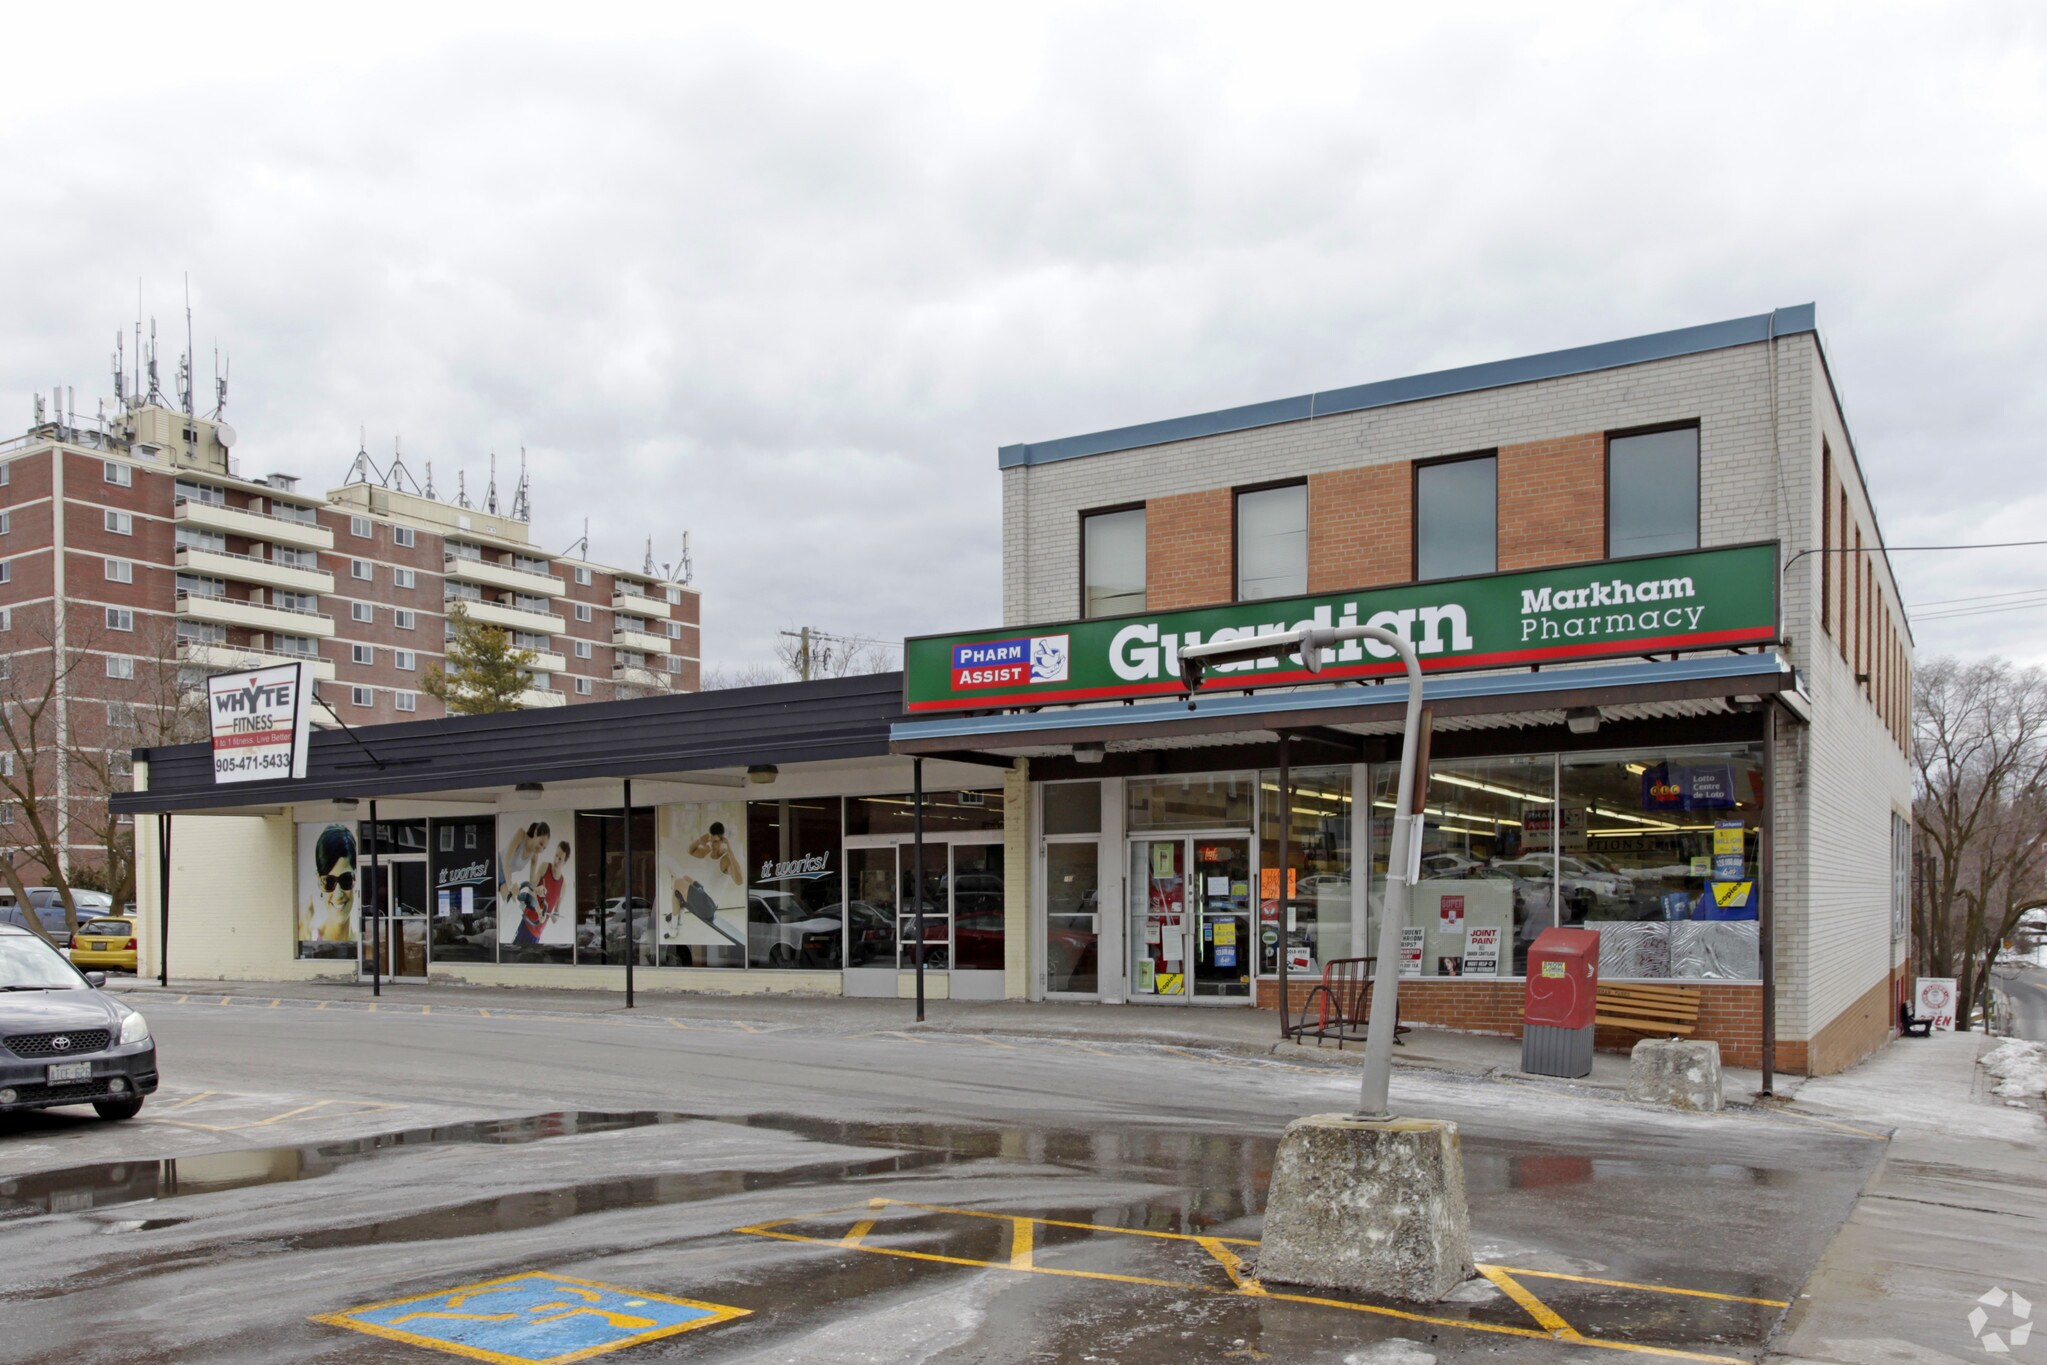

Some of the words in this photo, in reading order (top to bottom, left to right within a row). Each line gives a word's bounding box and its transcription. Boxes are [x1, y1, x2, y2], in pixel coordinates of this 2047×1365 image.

[1521, 576, 1695, 614] Markham
[1521, 605, 1705, 641] Pharmacy
[960, 646, 1022, 664] PHARM
[959, 667, 1022, 684] ASSIST
[215, 685, 290, 714] WHYTE
[233, 714, 273, 733] FITNESS
[256, 734, 270, 744] Live
[215, 753, 290, 773] 905-471-5433
[1693, 783, 1720, 791] Centre
[761, 861, 773, 878] it
[775, 851, 829, 877] works!
[1717, 882, 1742, 906] copies
[1160, 974, 1177, 993] copies
